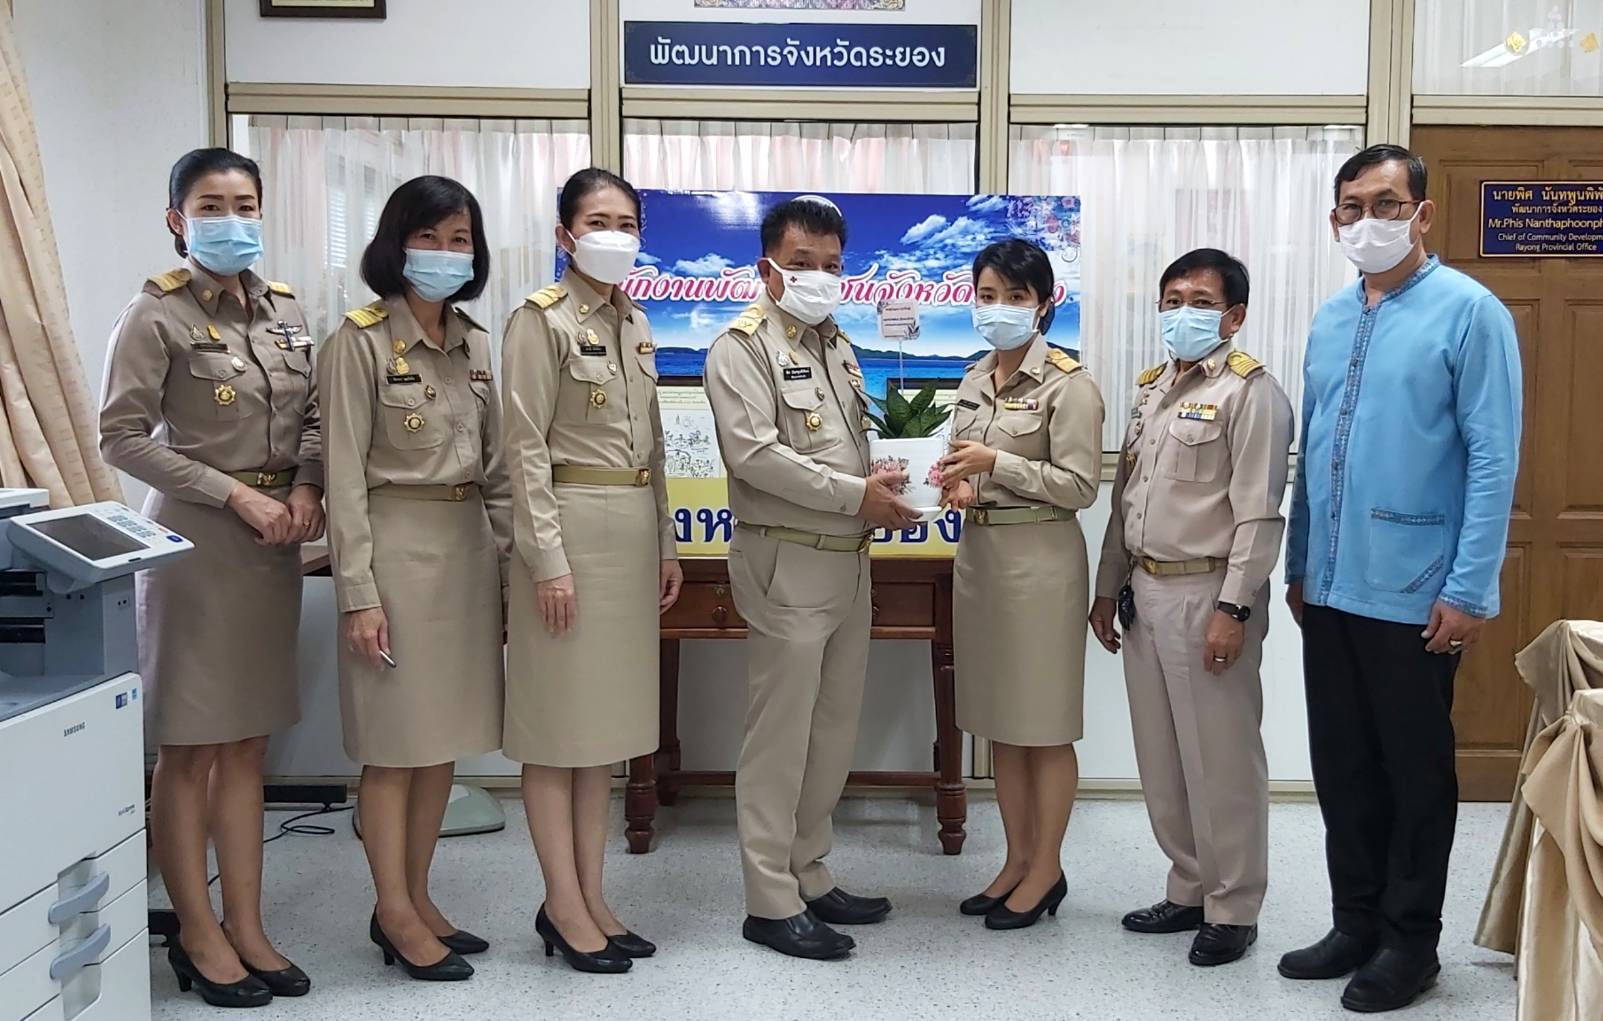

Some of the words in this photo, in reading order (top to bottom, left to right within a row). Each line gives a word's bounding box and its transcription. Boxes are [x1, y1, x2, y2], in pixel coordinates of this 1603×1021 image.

[650, 36, 945, 67] พัฒนาการจังหวัดระยอง
[1497, 233, 1516, 241] Chief
[1517, 233, 1525, 241] of
[1526, 233, 1567, 242] Community
[1516, 243, 1540, 252] Rayong
[1541, 243, 1575, 251] Provincial
[1576, 243, 1597, 251] Office
